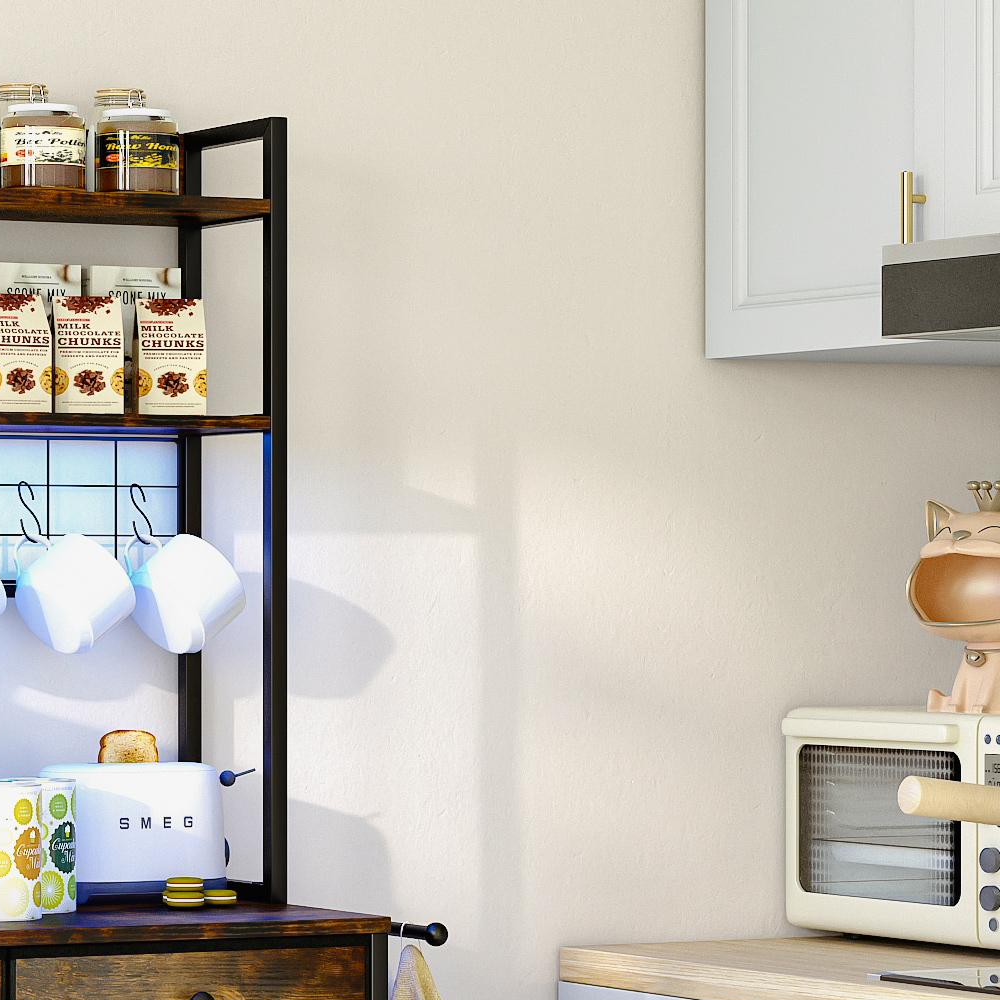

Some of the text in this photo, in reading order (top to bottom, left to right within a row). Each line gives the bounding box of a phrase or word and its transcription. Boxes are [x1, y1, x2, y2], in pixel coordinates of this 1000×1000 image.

[58, 337, 122, 346] CHUNKS
[141, 339, 205, 348] CHUNKS
[119, 816, 194, 830] SMEG
